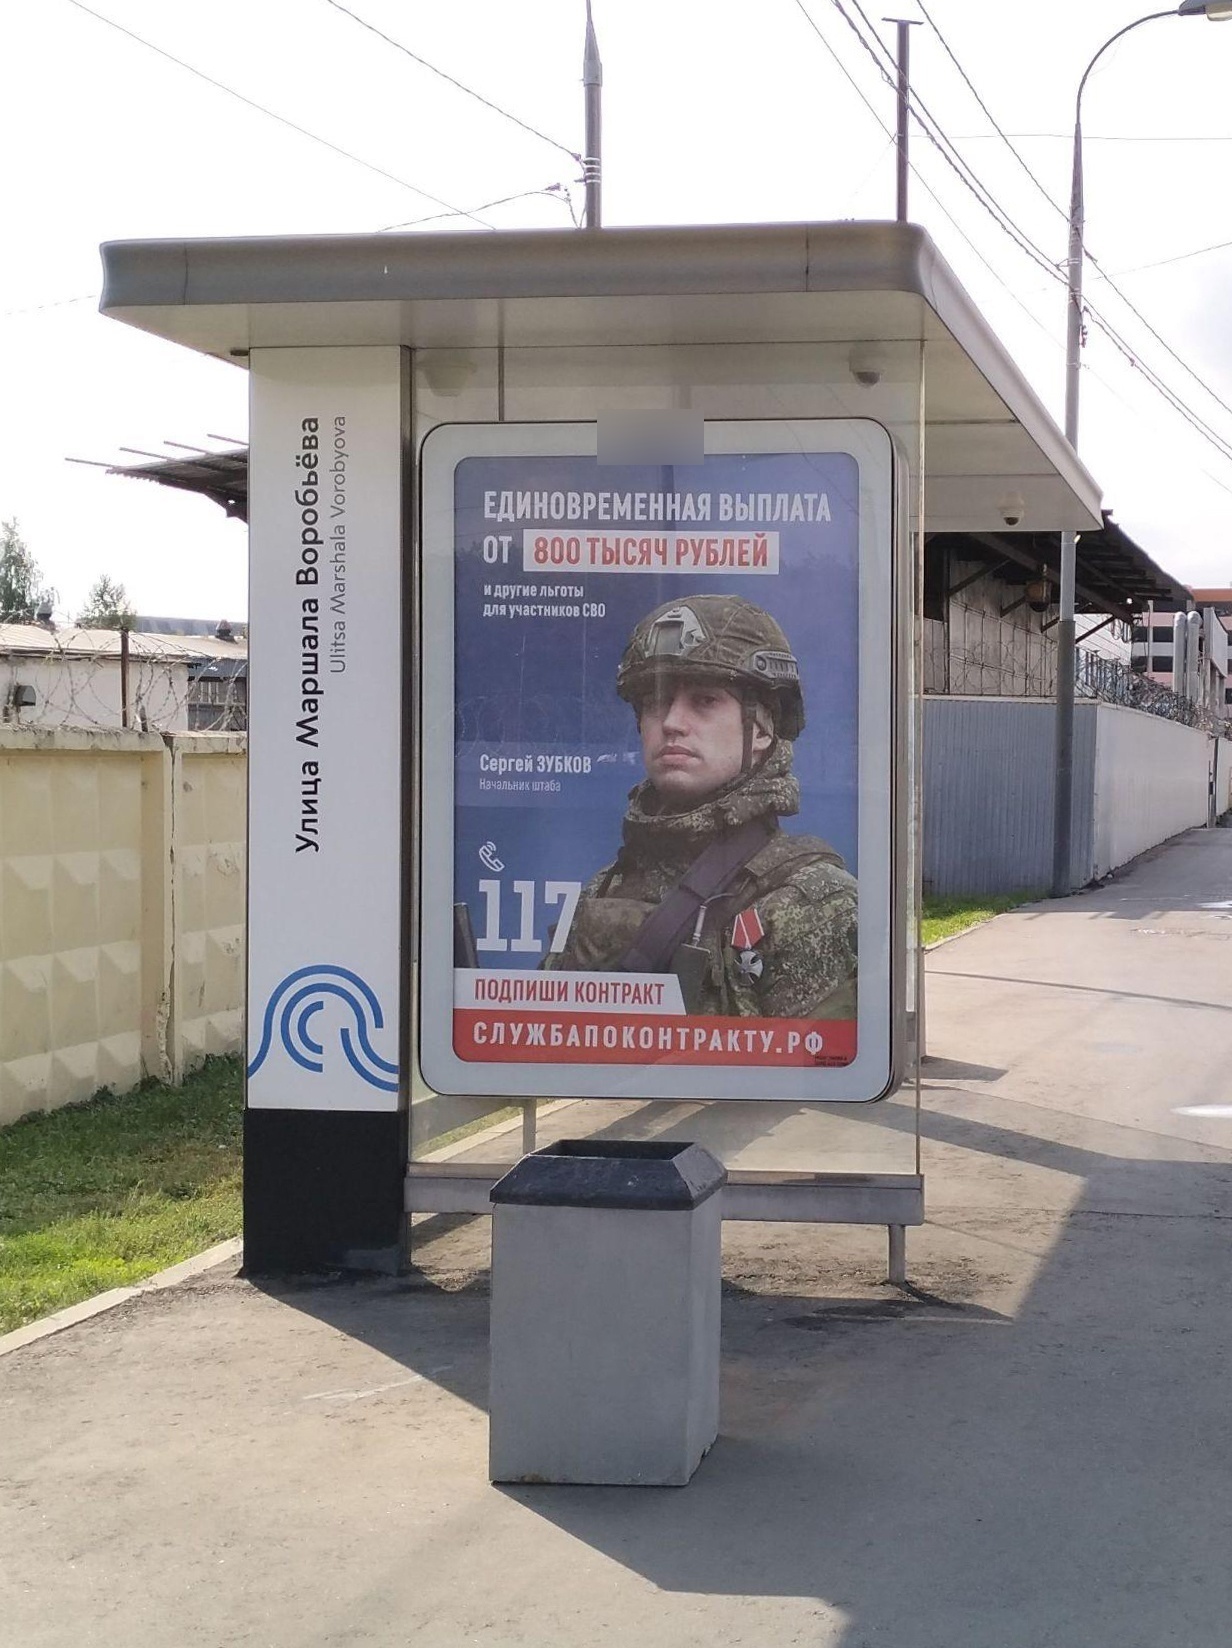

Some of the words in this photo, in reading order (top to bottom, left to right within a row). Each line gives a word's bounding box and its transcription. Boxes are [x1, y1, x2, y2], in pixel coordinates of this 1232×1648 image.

[330, 415, 349, 519] Vorobyova
[295, 416, 324, 586] Воробьёва
[483, 491, 710, 522] ЕДИНОВРЕМЕННАЯ
[718, 493, 831, 522] ВЫПЛАТА
[483, 535, 512, 564] ОТ
[533, 536, 580, 566] 800
[587, 536, 667, 567] ТЫСЯЧ
[675, 533, 768, 568] РУБЛЕЙ
[330, 525, 347, 613] Marshala
[483, 584, 492, 596] и
[494, 585, 537, 599] другие
[540, 585, 584, 598] льготы
[483, 603, 506, 617] для
[509, 604, 580, 619] участников
[582, 603, 606, 617] СВО
[330, 619, 347, 673] Ulitsa
[295, 597, 324, 748] Маршала
[480, 754, 533, 775] Сергей
[536, 755, 592, 773] ЗУБКОВ
[479, 778, 530, 791] Начальник
[532, 779, 561, 792] штаба
[295, 760, 323, 854] Улица
[476, 879, 582, 953] 117
[474, 977, 568, 1002] ПОДПИШИ
[574, 980, 665, 1006] КОНТРАКТ
[473, 1021, 824, 1056] СЛУЖБАПОКОНТРАКТУ.РФ
